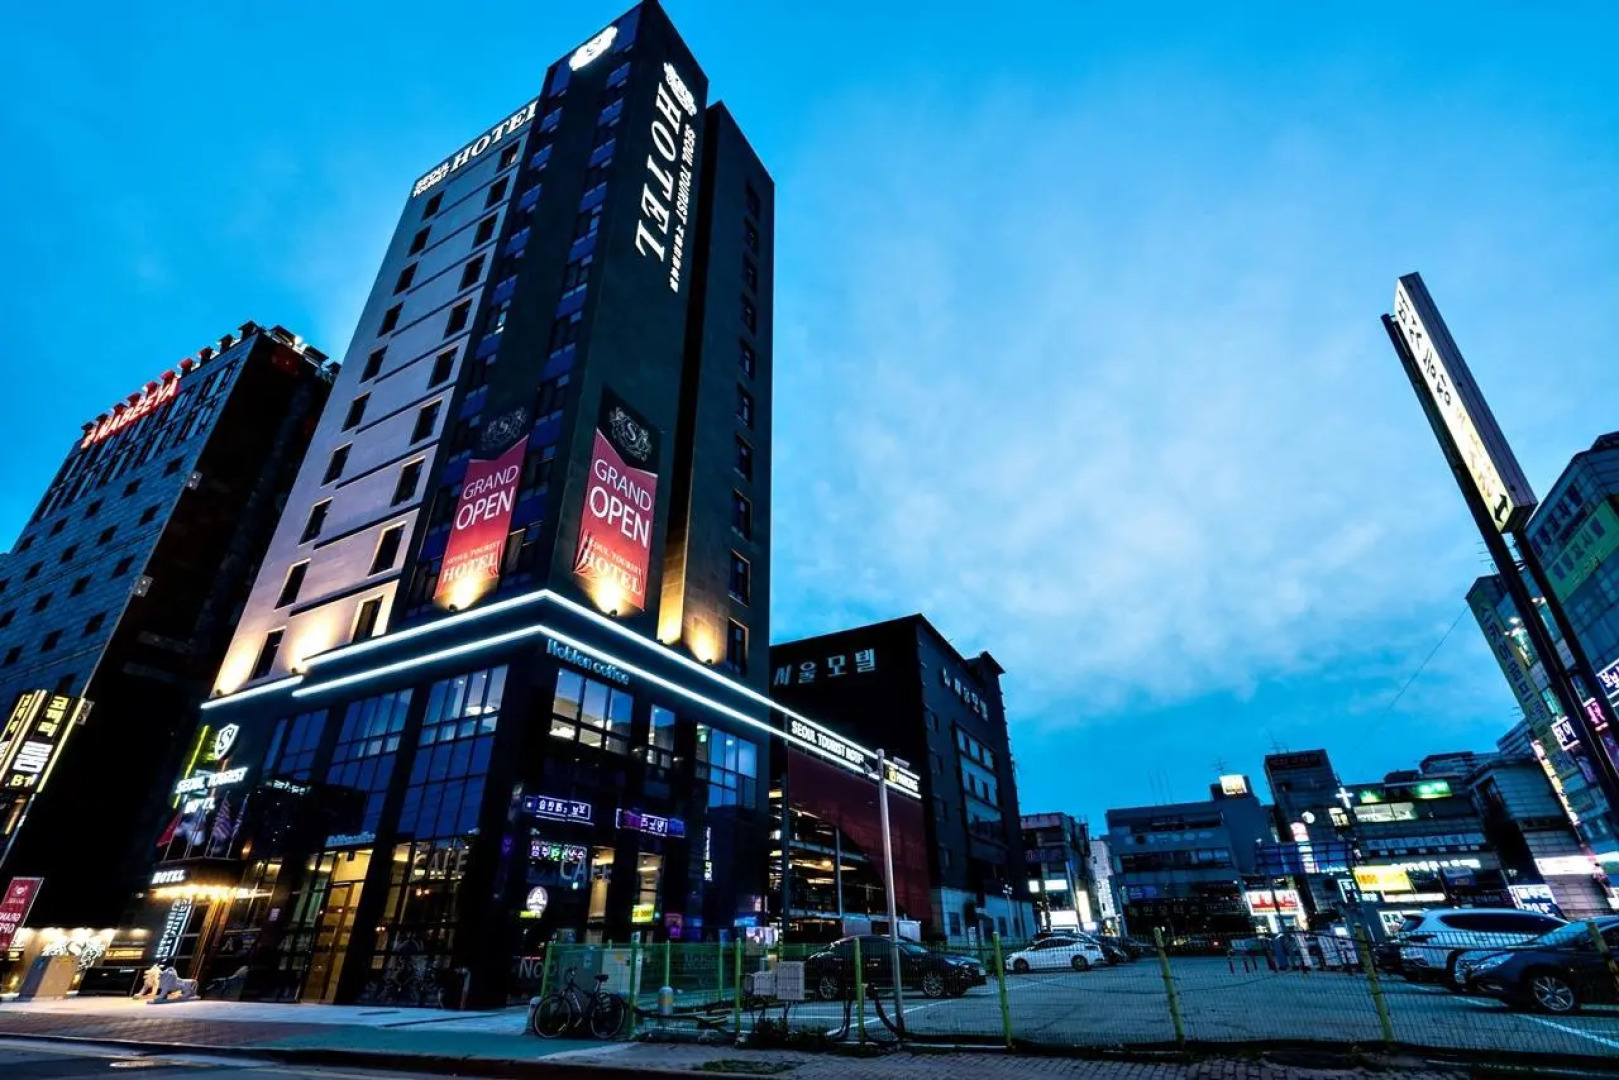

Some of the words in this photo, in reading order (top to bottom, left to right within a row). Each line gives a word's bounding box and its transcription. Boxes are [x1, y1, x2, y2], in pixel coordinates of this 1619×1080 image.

[682, 124, 696, 166] SEOUL
[635, 82, 682, 262] HOTEL
[676, 165, 692, 225] TOURIST
[463, 465, 519, 500] GRAND
[595, 459, 651, 511] GRAND
[456, 487, 515, 530] OPEN
[589, 487, 650, 547] OPEN
[792, 720, 817, 744] SEOUL
[817, 733, 845, 757] TOURIST
